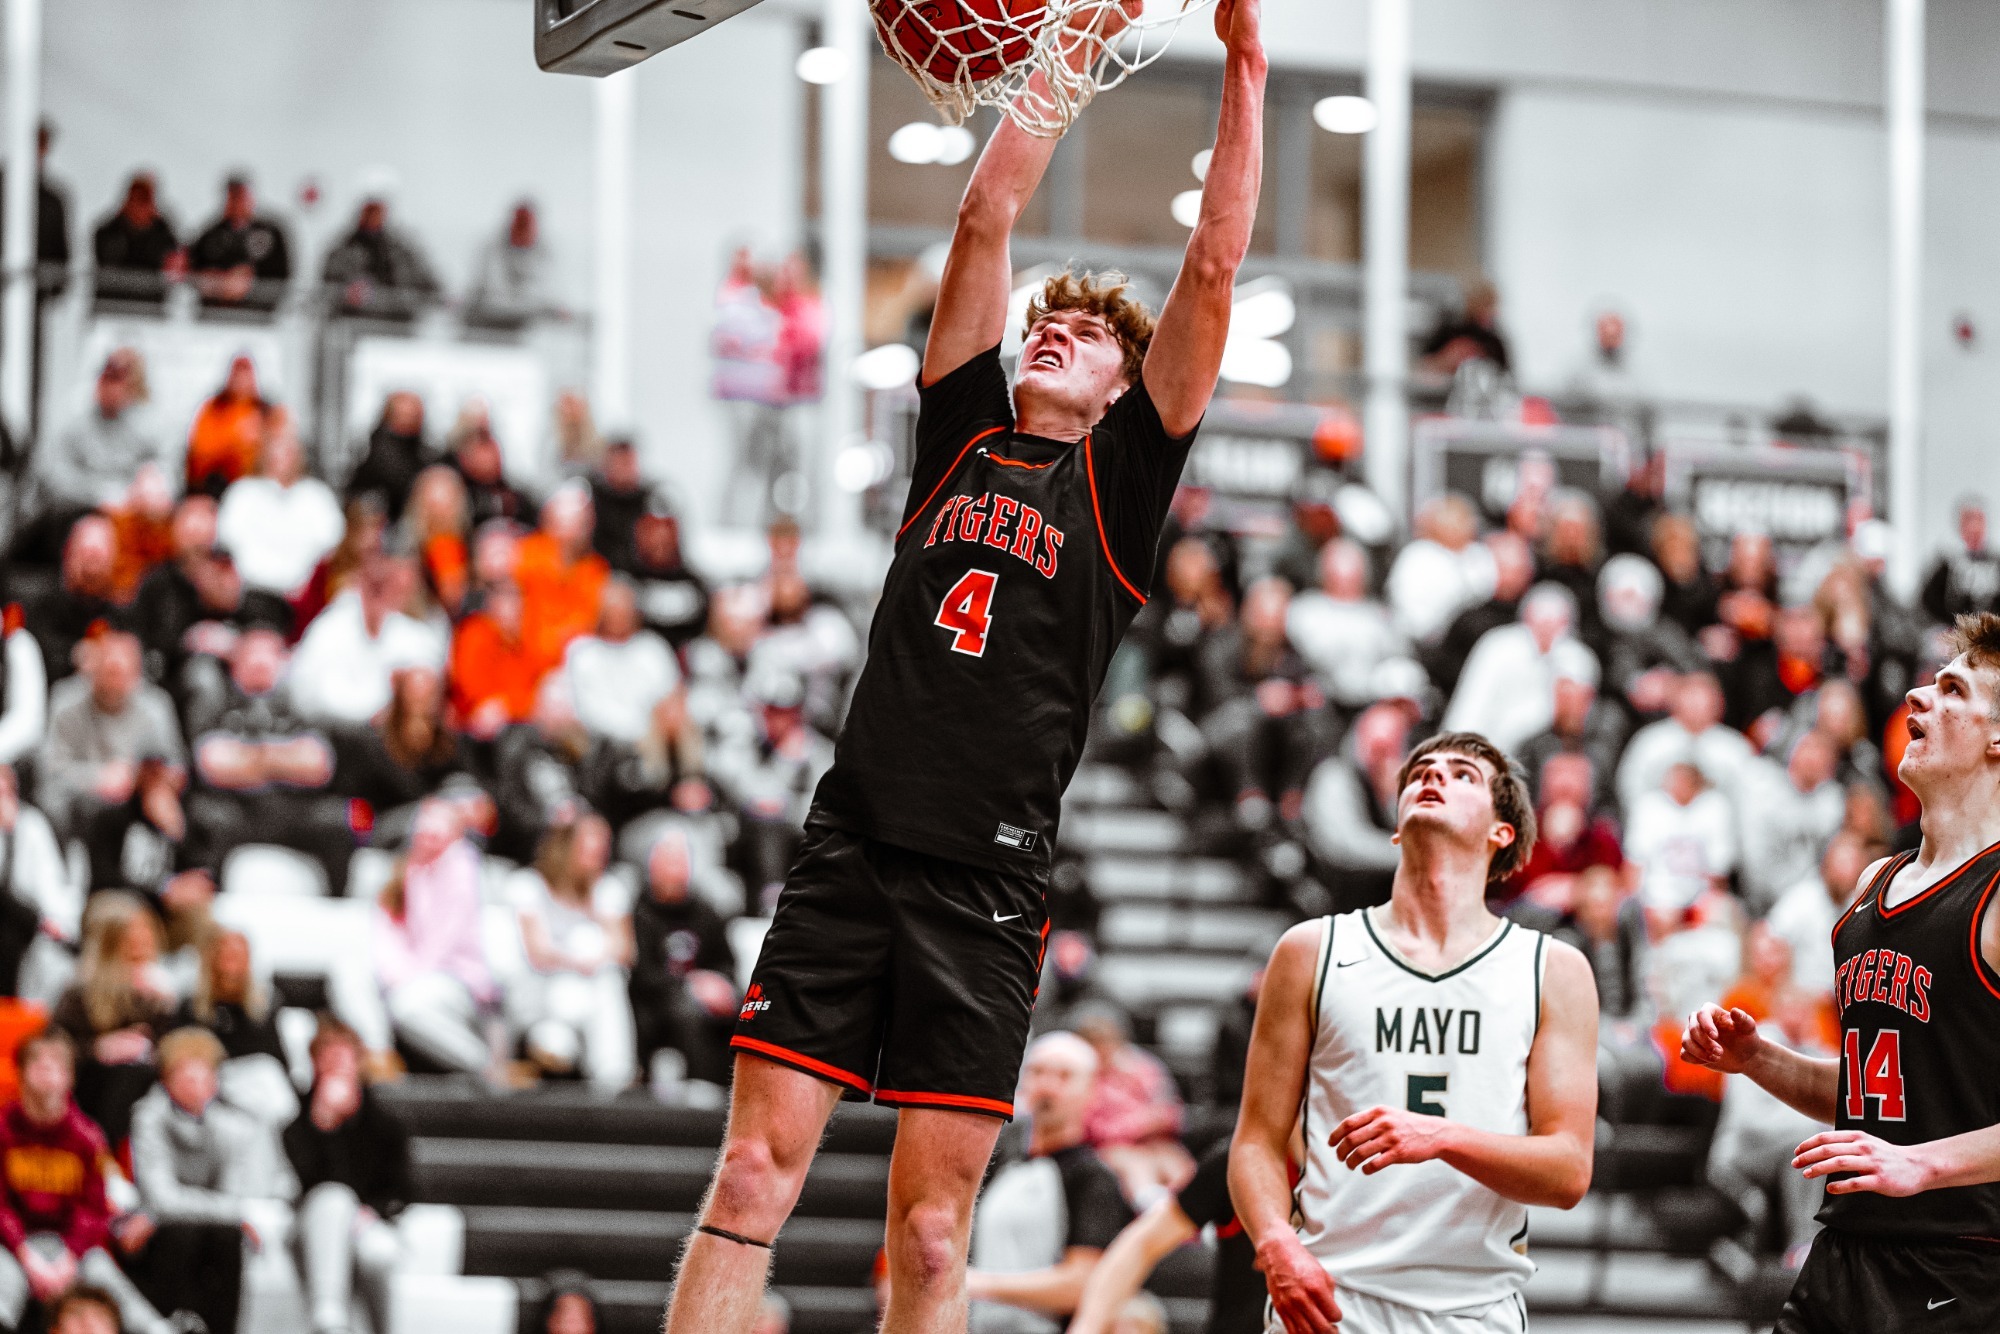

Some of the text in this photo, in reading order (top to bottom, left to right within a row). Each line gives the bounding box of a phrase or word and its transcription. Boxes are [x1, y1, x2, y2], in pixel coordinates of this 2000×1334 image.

[924, 491, 1065, 580] TIGERS
[934, 568, 1000, 658] 4
[740, 1000, 772, 1014] GERS
[1835, 948, 1933, 1024] TIGERS
[1375, 1006, 1481, 1056] MAYO
[1844, 1028, 1907, 1122] 14
